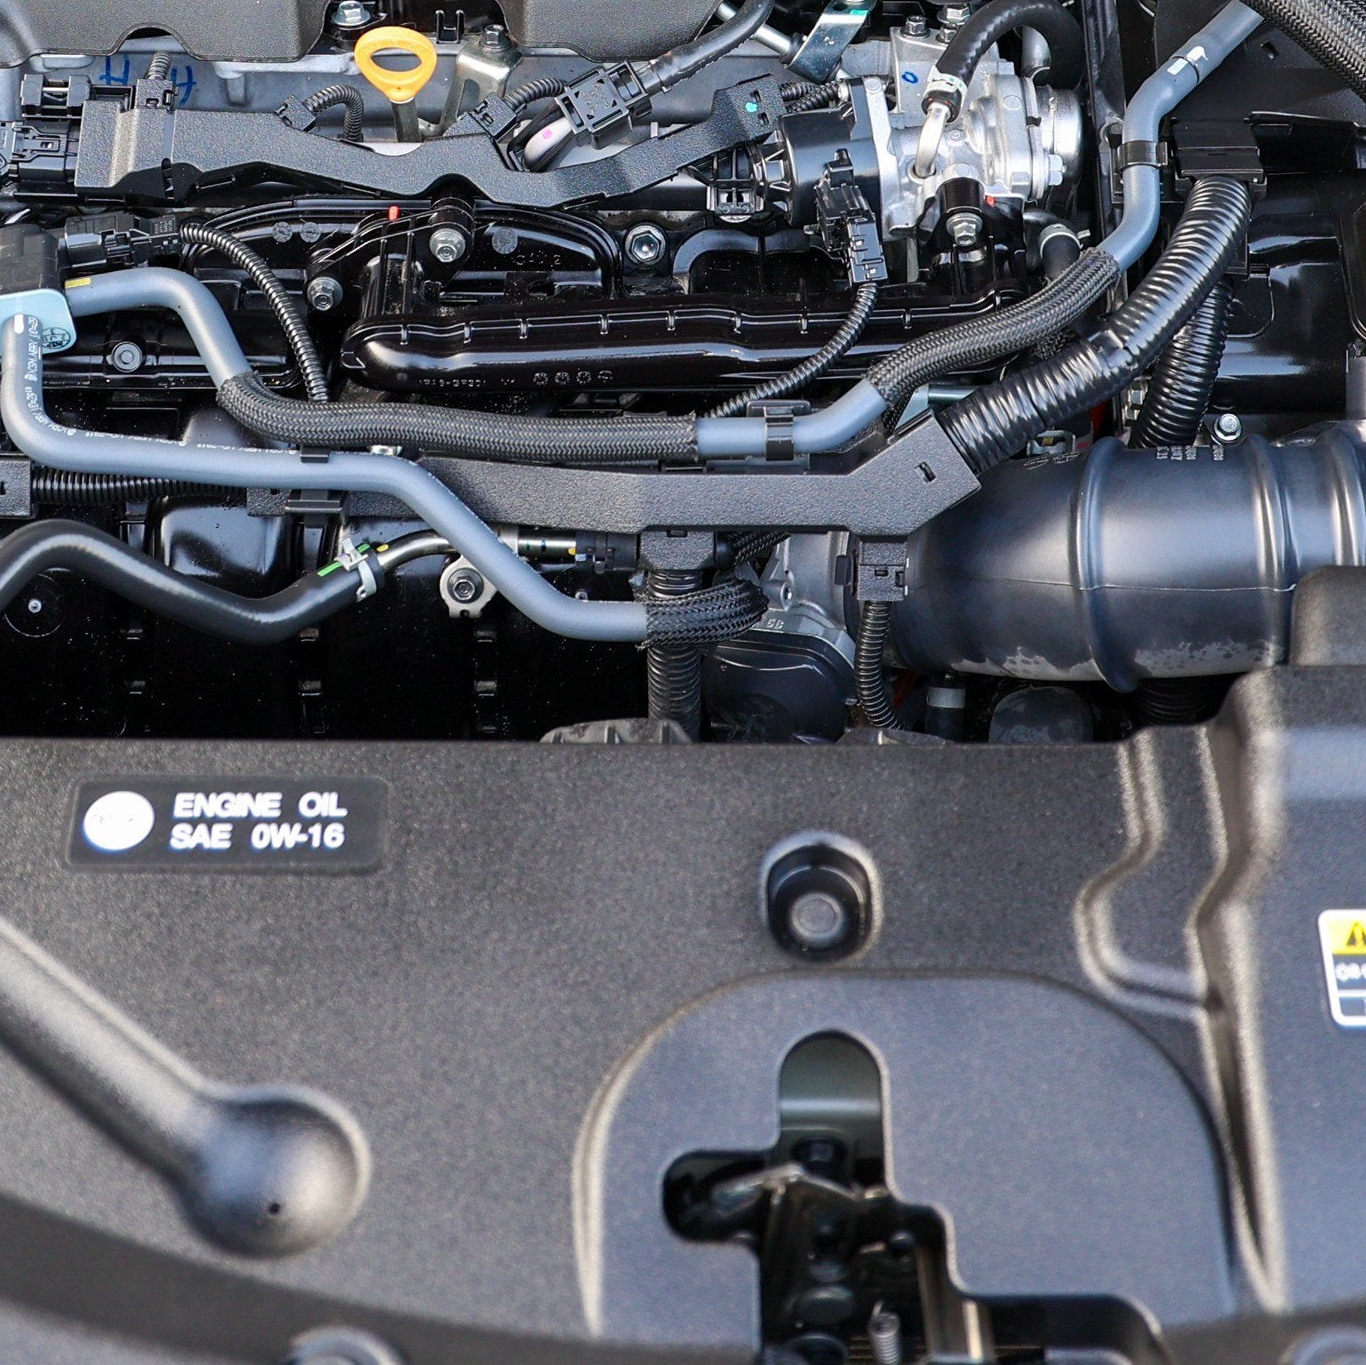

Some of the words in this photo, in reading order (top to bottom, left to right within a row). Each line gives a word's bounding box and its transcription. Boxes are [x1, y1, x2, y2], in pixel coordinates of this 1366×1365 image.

[172, 791, 283, 819] ENGINE
[297, 790, 349, 819] OIL
[168, 822, 234, 851] SAE
[250, 821, 346, 851] 0W-16
